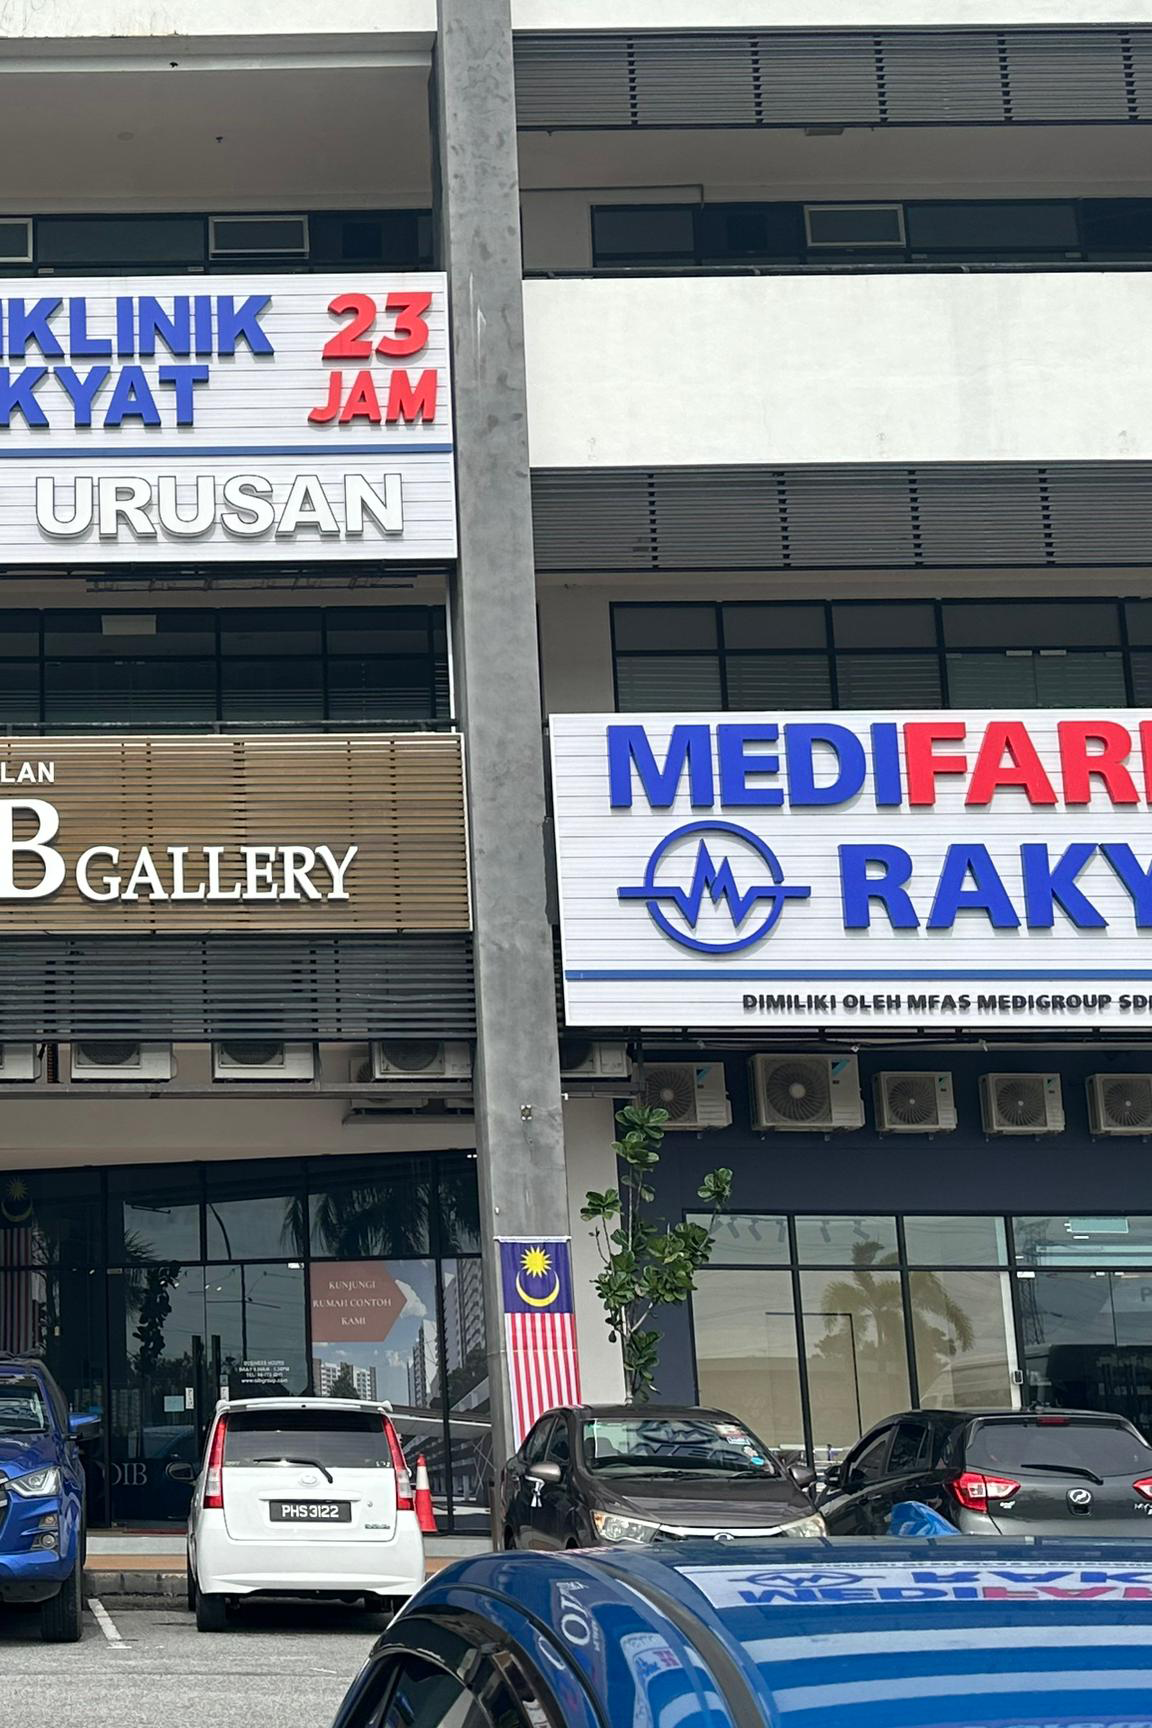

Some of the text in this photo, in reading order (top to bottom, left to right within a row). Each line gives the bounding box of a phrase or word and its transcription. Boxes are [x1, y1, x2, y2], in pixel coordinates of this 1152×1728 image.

[322, 291, 433, 360] 23
[307, 368, 438, 426] JAM
[34, 473, 405, 541] URUSAN
[607, 721, 1152, 808] MEDIFAR
[75, 844, 359, 904] GALLERY
[742, 994, 1152, 1010] DIMILIKI OLEH MFAS MEDIGROUP SD
[312, 1298, 392, 1308] RUMAH CONTOH
[328, 1280, 376, 1291] KUNJUNGI
[341, 1317, 366, 1326] KAMI
